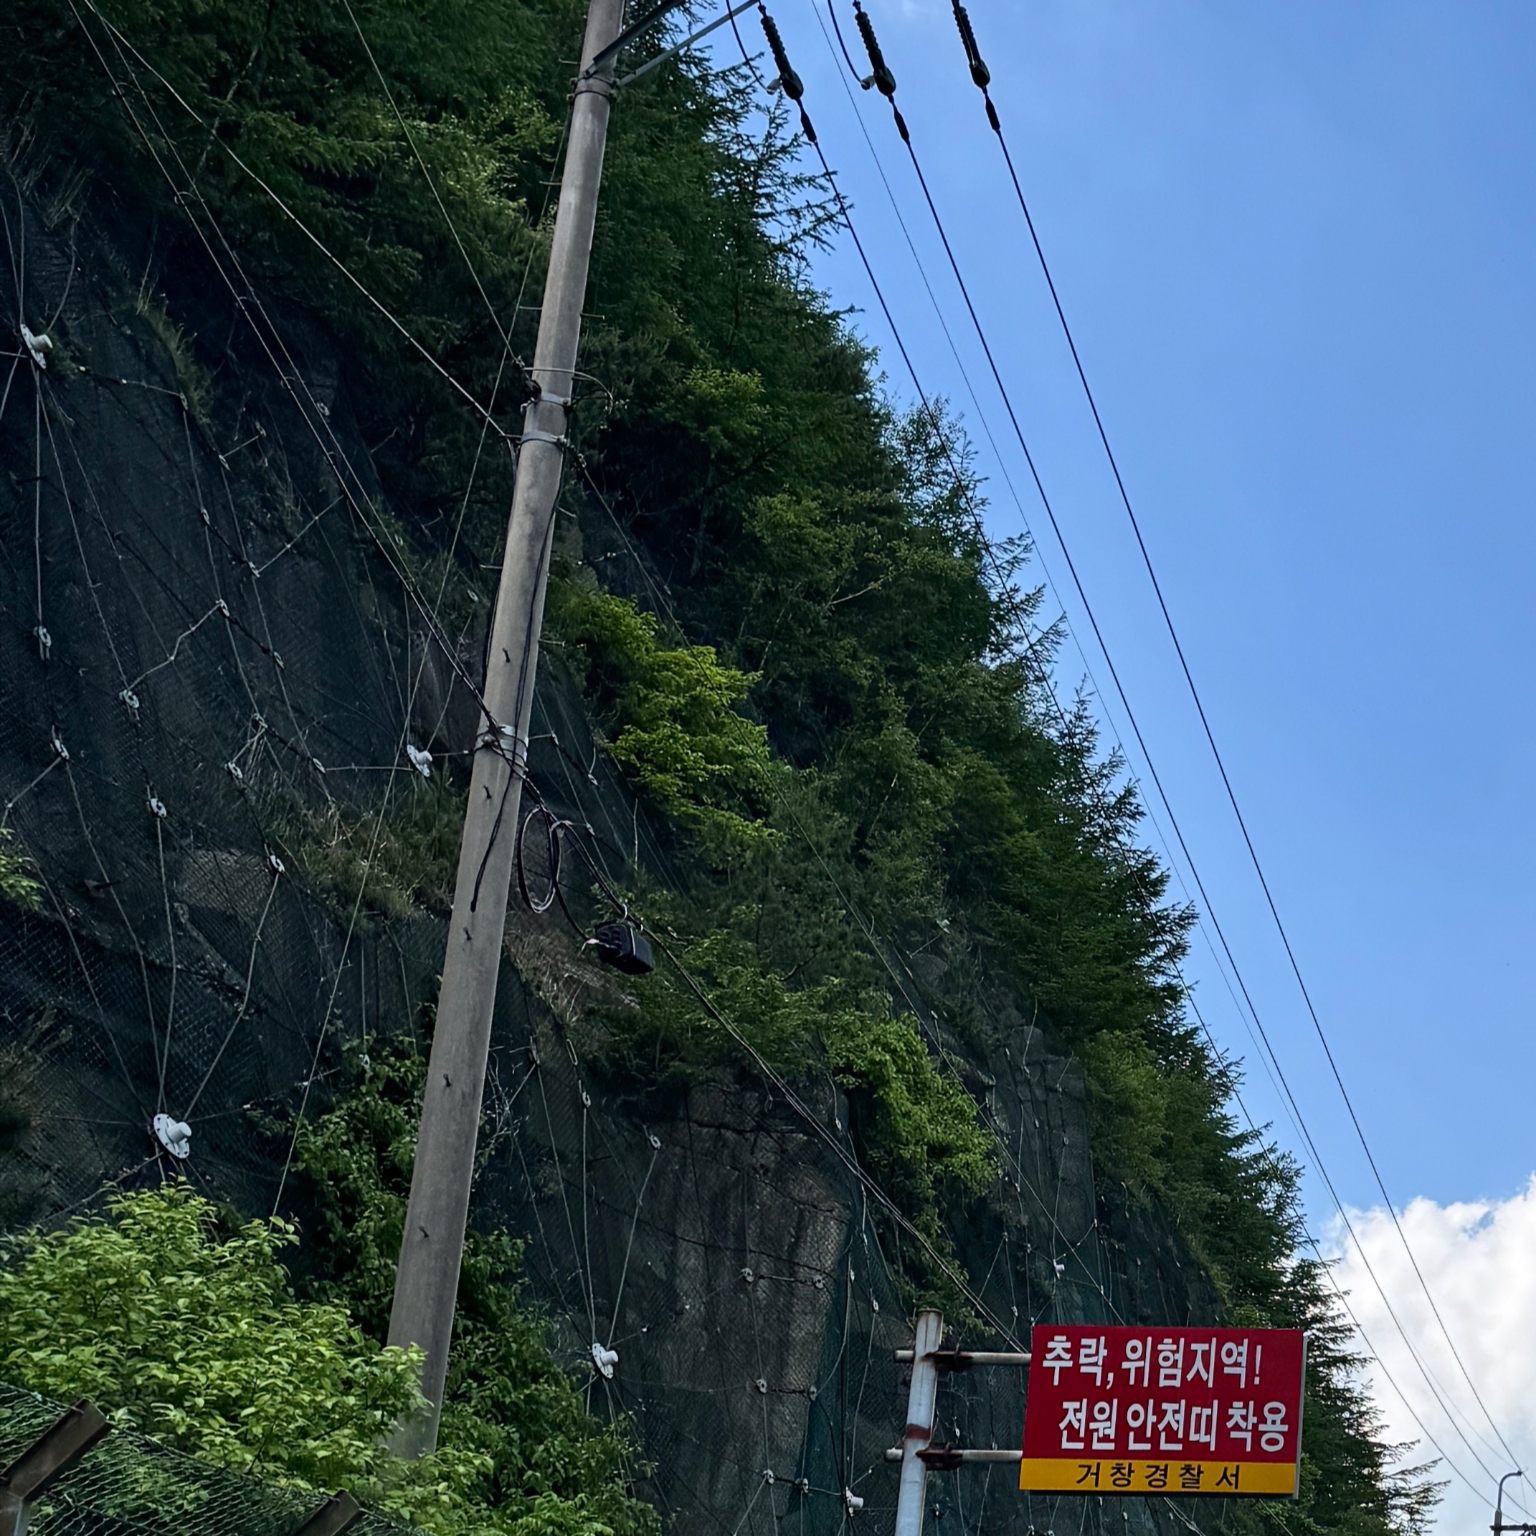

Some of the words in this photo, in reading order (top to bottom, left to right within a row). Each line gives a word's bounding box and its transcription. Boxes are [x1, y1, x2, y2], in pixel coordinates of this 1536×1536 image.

[1042, 1335, 1114, 1390] 추락,
[1121, 1336, 1262, 1389] 위험지역!
[1058, 1398, 1118, 1450] 전원
[1125, 1398, 1219, 1451] 안전띠
[1226, 1401, 1289, 1452] 착용
[1076, 1461, 1241, 1490] 거창경찰서
